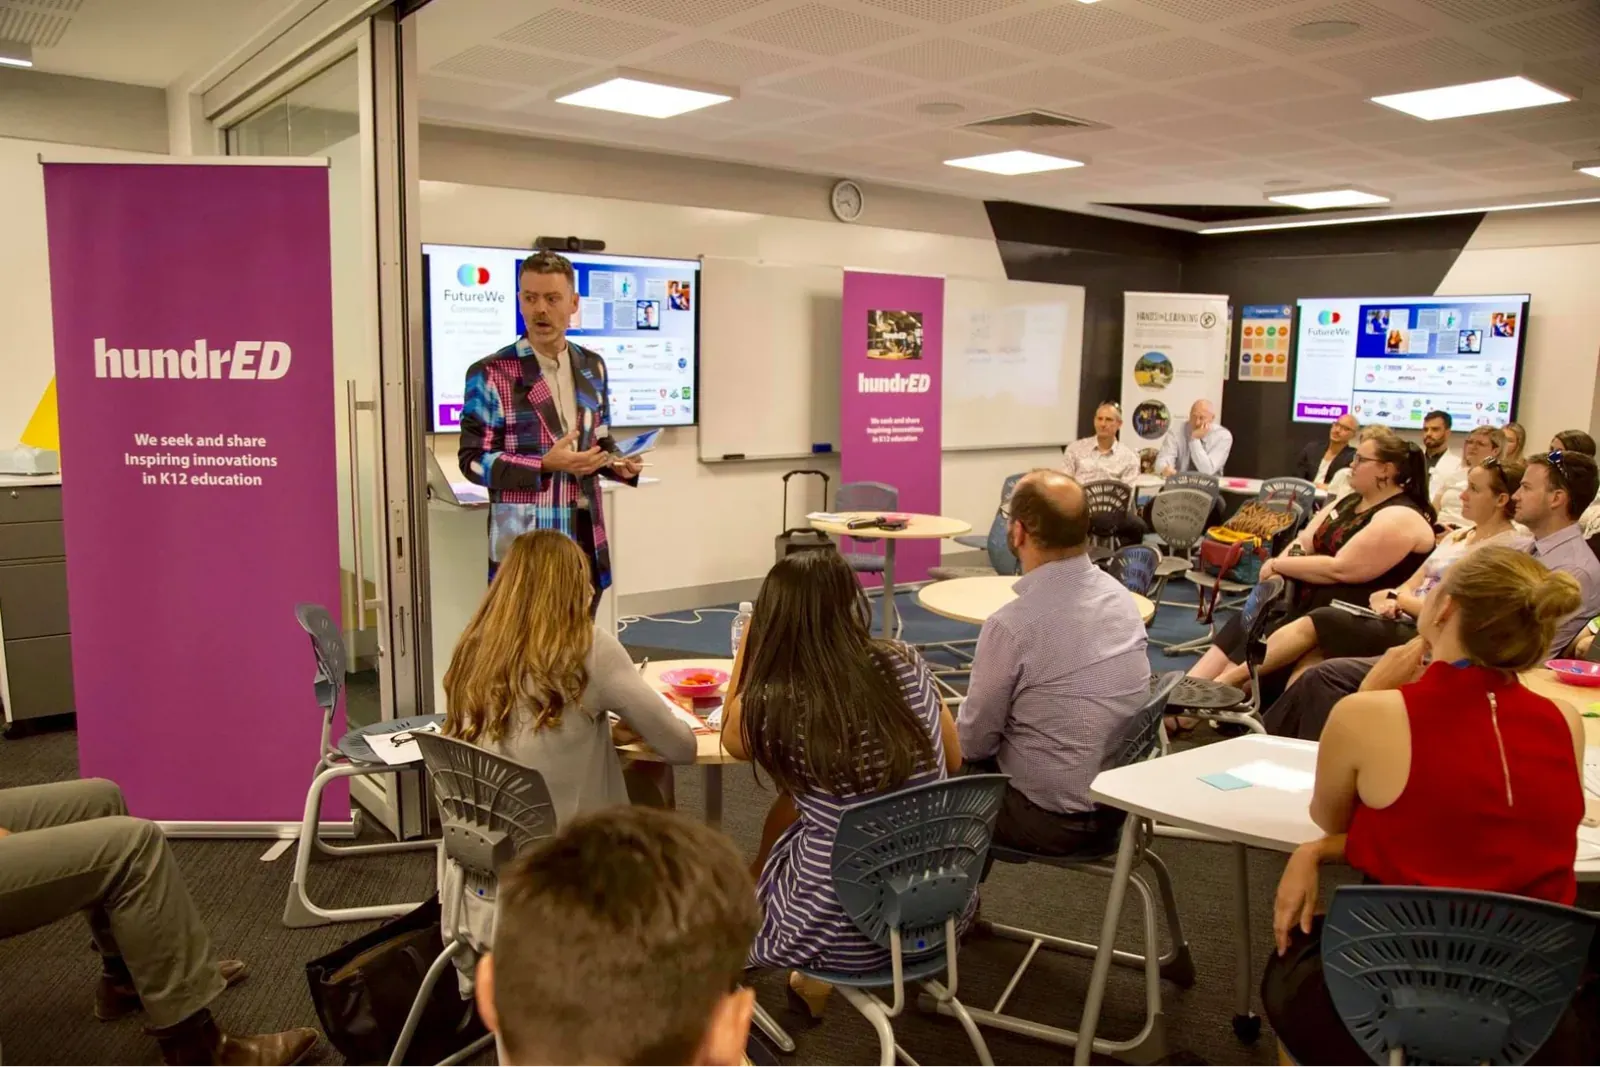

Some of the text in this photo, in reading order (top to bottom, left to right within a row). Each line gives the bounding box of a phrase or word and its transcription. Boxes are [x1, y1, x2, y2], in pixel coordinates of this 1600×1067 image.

[444, 289, 505, 303] FutureWe
[1164, 312, 1198, 322] LEARNING
[1308, 328, 1350, 336] FutureWe
[94, 338, 291, 380] hundrED
[858, 372, 930, 393] hundrED
[893, 416, 904, 424] and
[905, 416, 920, 424] share
[134, 434, 266, 447] We seek and share
[125, 453, 278, 469] Inspiring innovations
[143, 473, 263, 486] in K12 education
